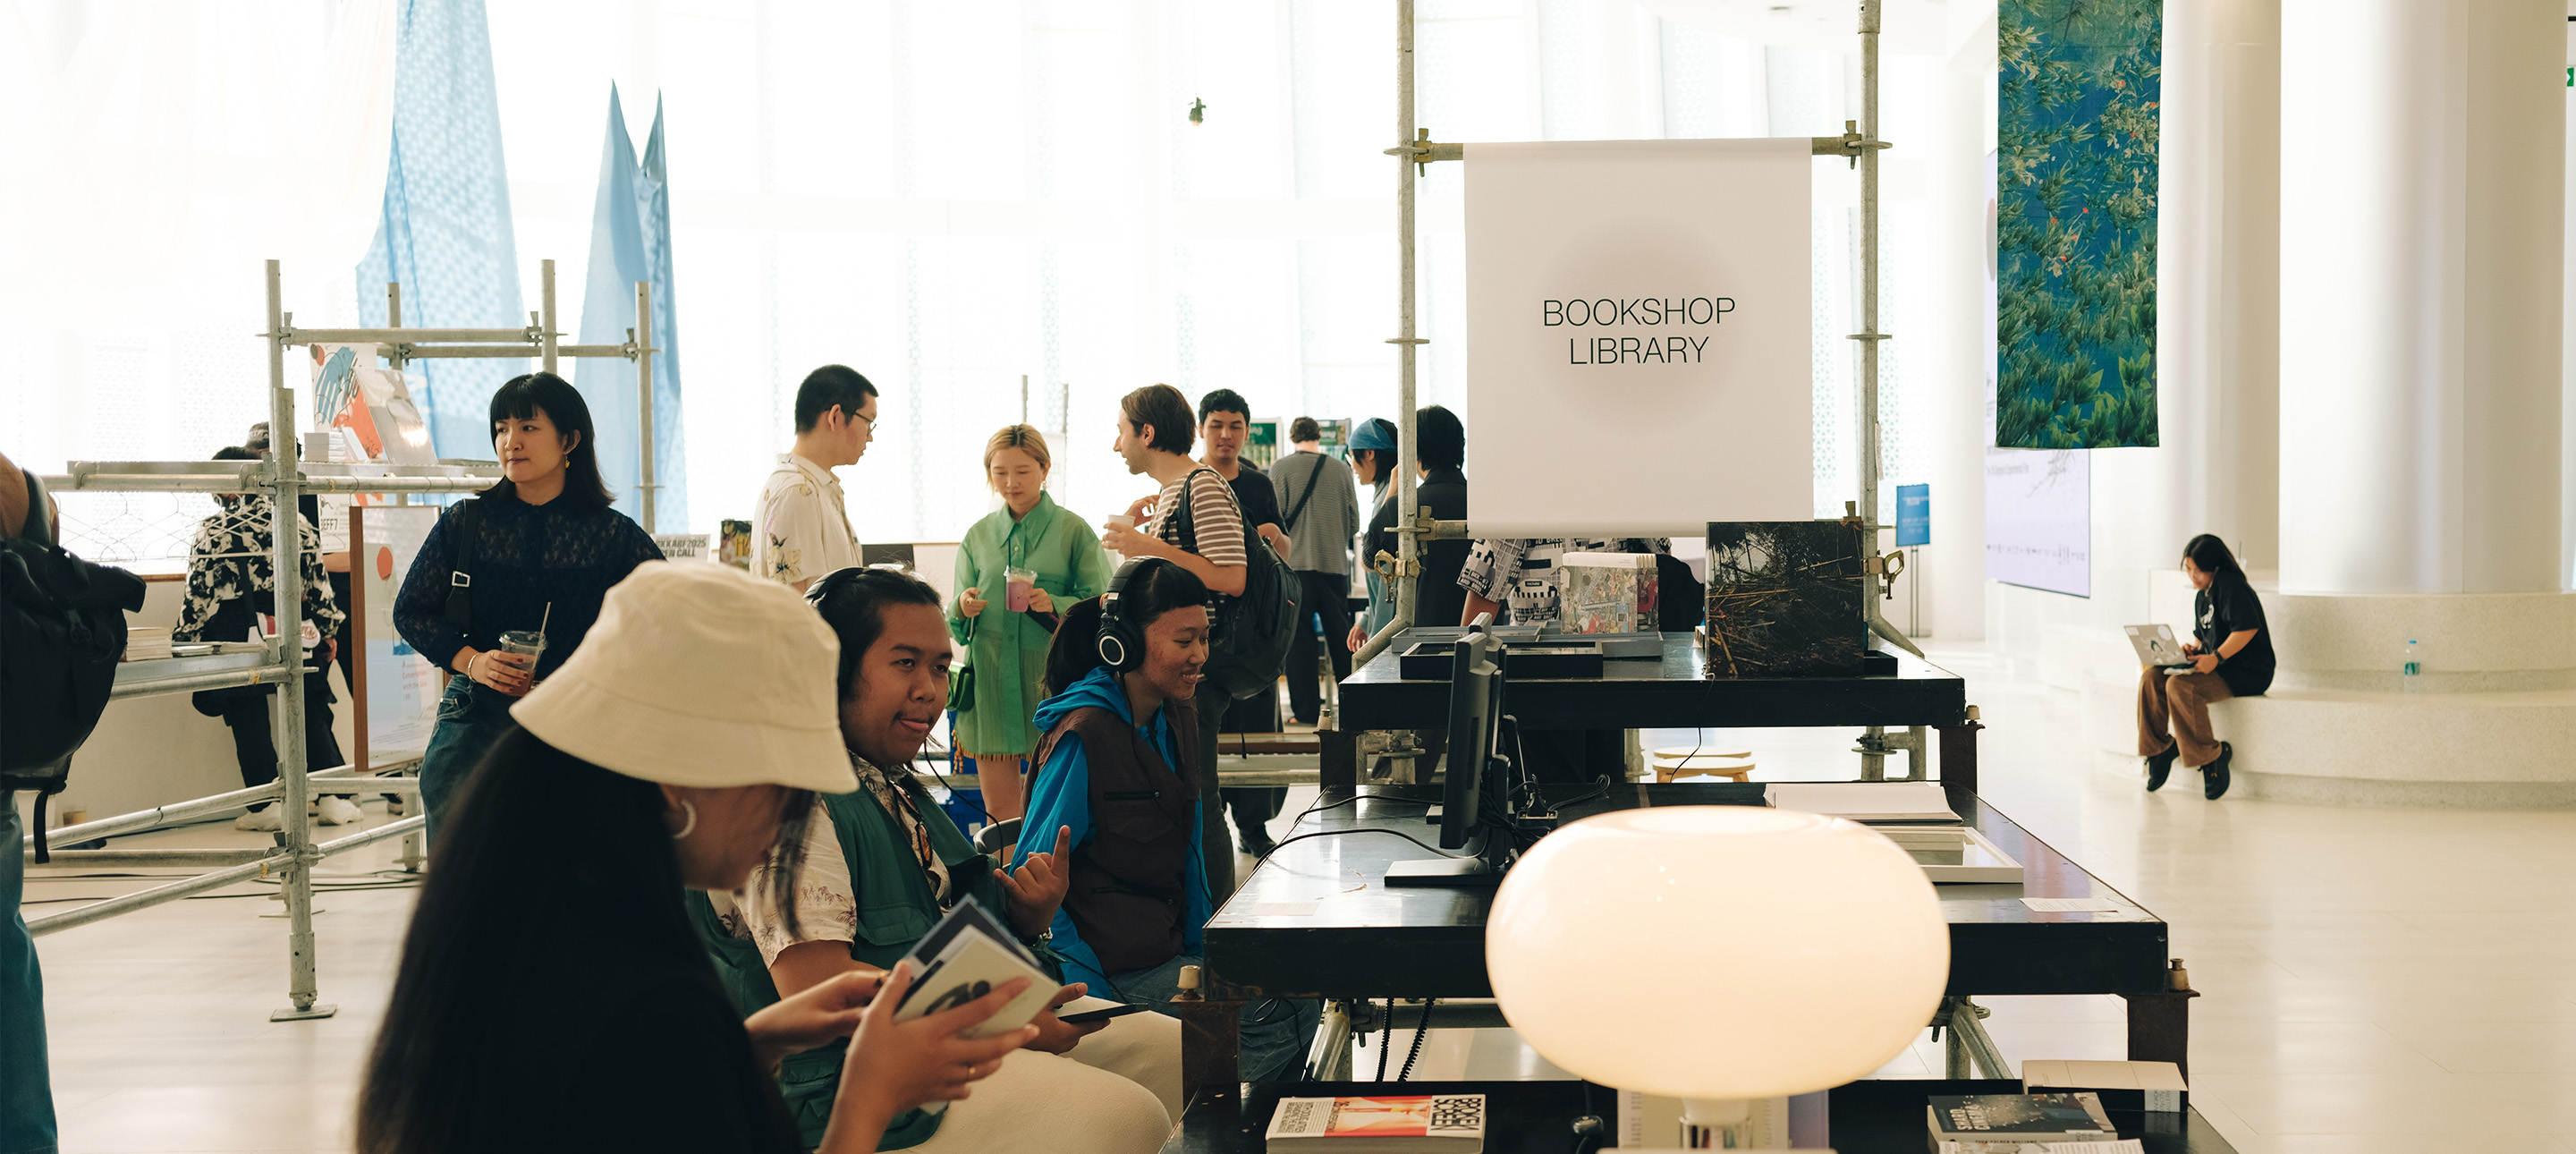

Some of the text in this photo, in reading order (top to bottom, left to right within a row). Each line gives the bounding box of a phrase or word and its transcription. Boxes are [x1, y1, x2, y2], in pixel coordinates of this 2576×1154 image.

[1543, 297, 1736, 327] BOOKSHOP
[1570, 335, 1709, 365] LIBRARY
[676, 548, 696, 557] CALL
[1430, 1099, 1459, 1131] SCREEN
[1453, 1098, 1482, 1131] BROKEN
[1950, 1108, 1973, 1130] SHARD
